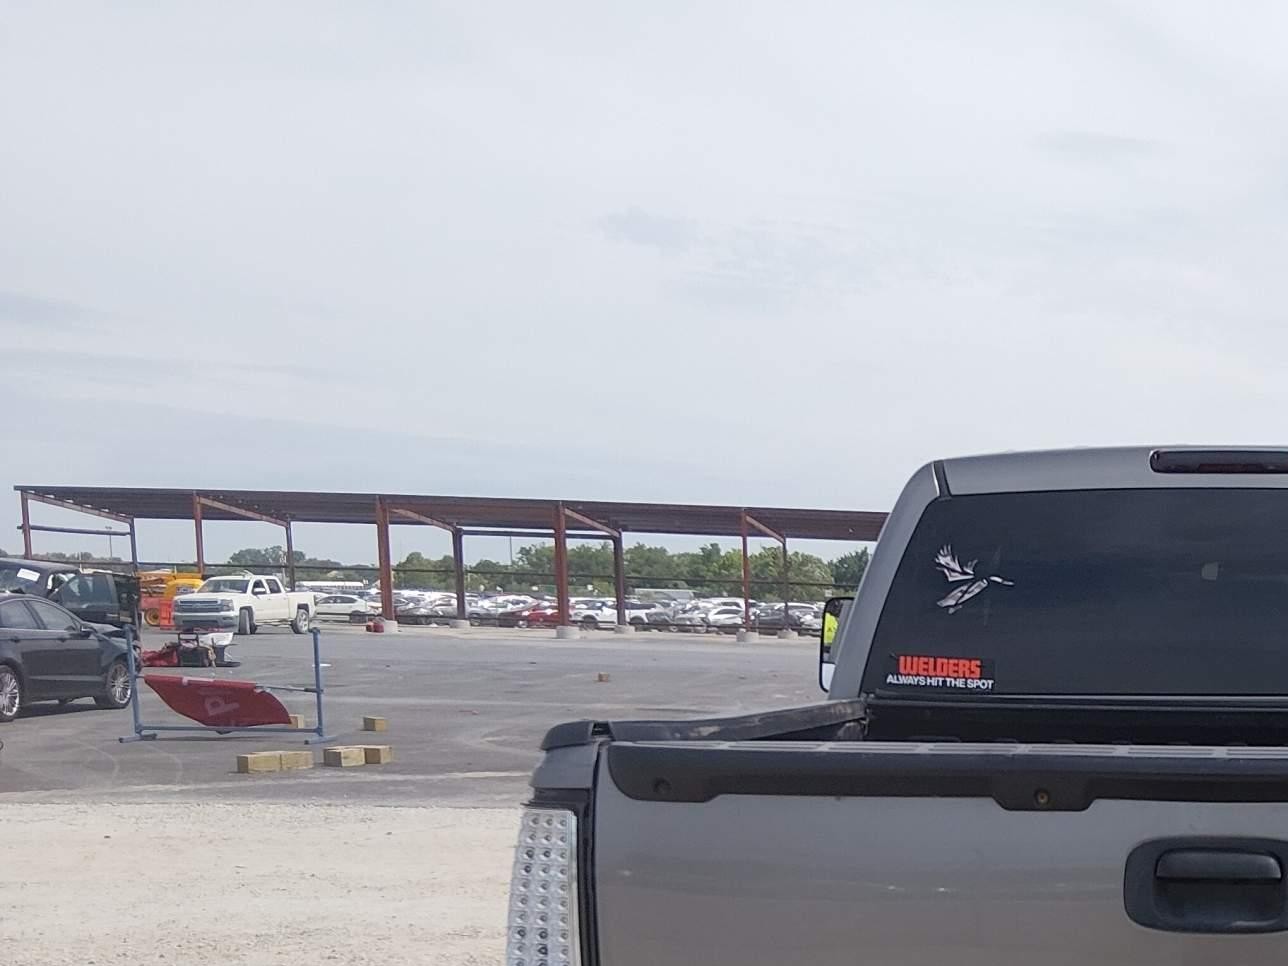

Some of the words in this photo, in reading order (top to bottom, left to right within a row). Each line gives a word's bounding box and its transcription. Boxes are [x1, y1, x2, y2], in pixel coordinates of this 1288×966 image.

[899, 655, 981, 679] WELDERS
[886, 674, 926, 686] ALWAYS
[926, 676, 944, 687] HIT
[944, 678, 966, 688] THE
[966, 679, 995, 690] SPOT
